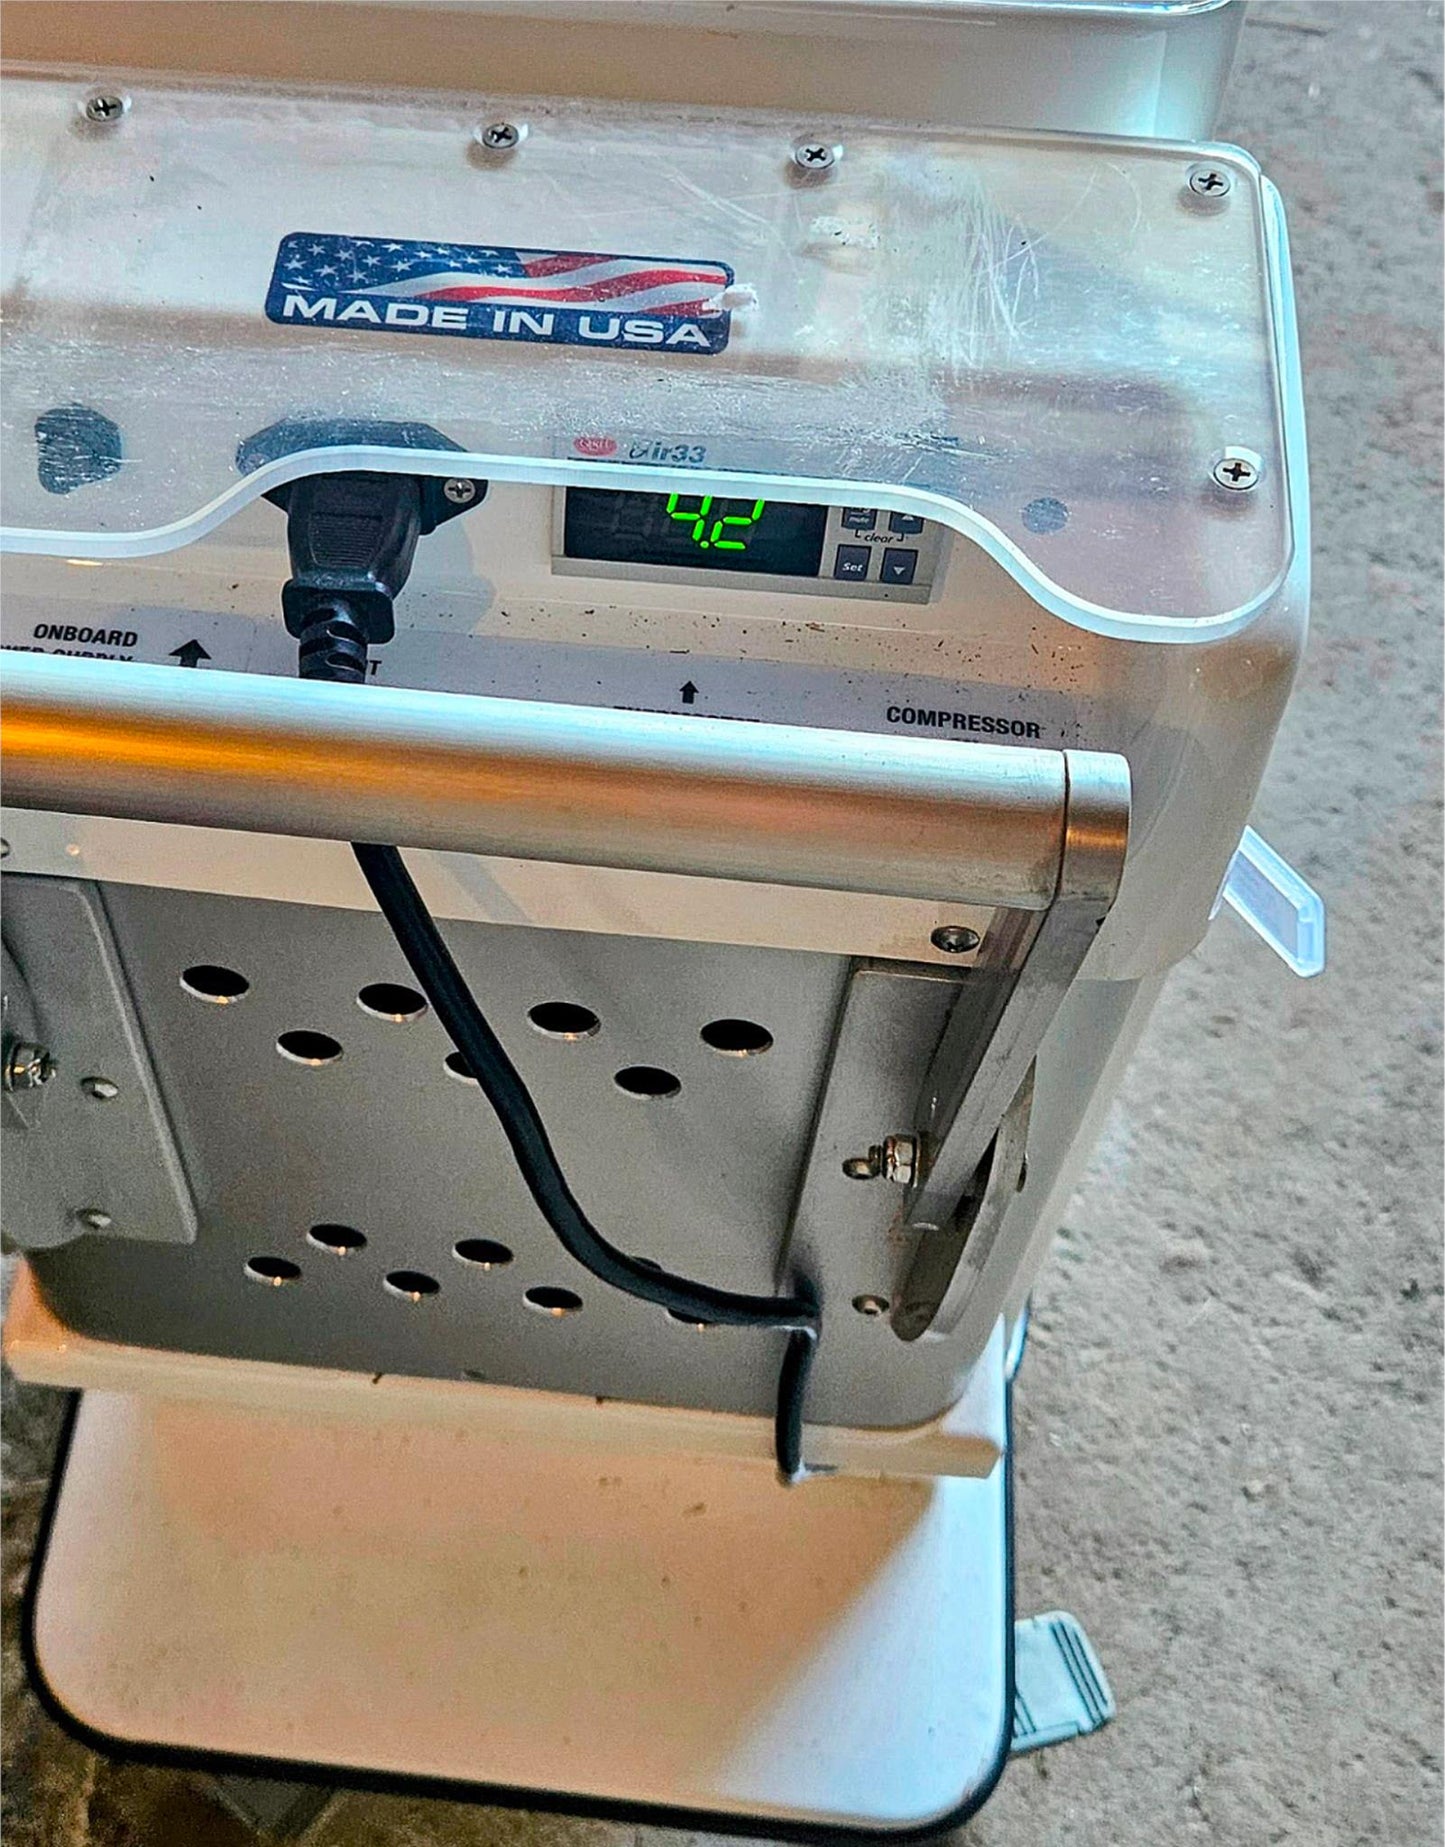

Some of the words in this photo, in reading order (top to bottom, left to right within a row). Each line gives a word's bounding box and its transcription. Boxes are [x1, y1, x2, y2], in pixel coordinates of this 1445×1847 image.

[282, 295, 470, 330] MADE
[493, 310, 555, 336] IN
[579, 316, 711, 348] USA
[864, 532, 894, 544] clear
[842, 561, 863, 573] Set
[33, 623, 138, 648] ONBOARD
[886, 705, 1041, 739] COMPRESSOR
